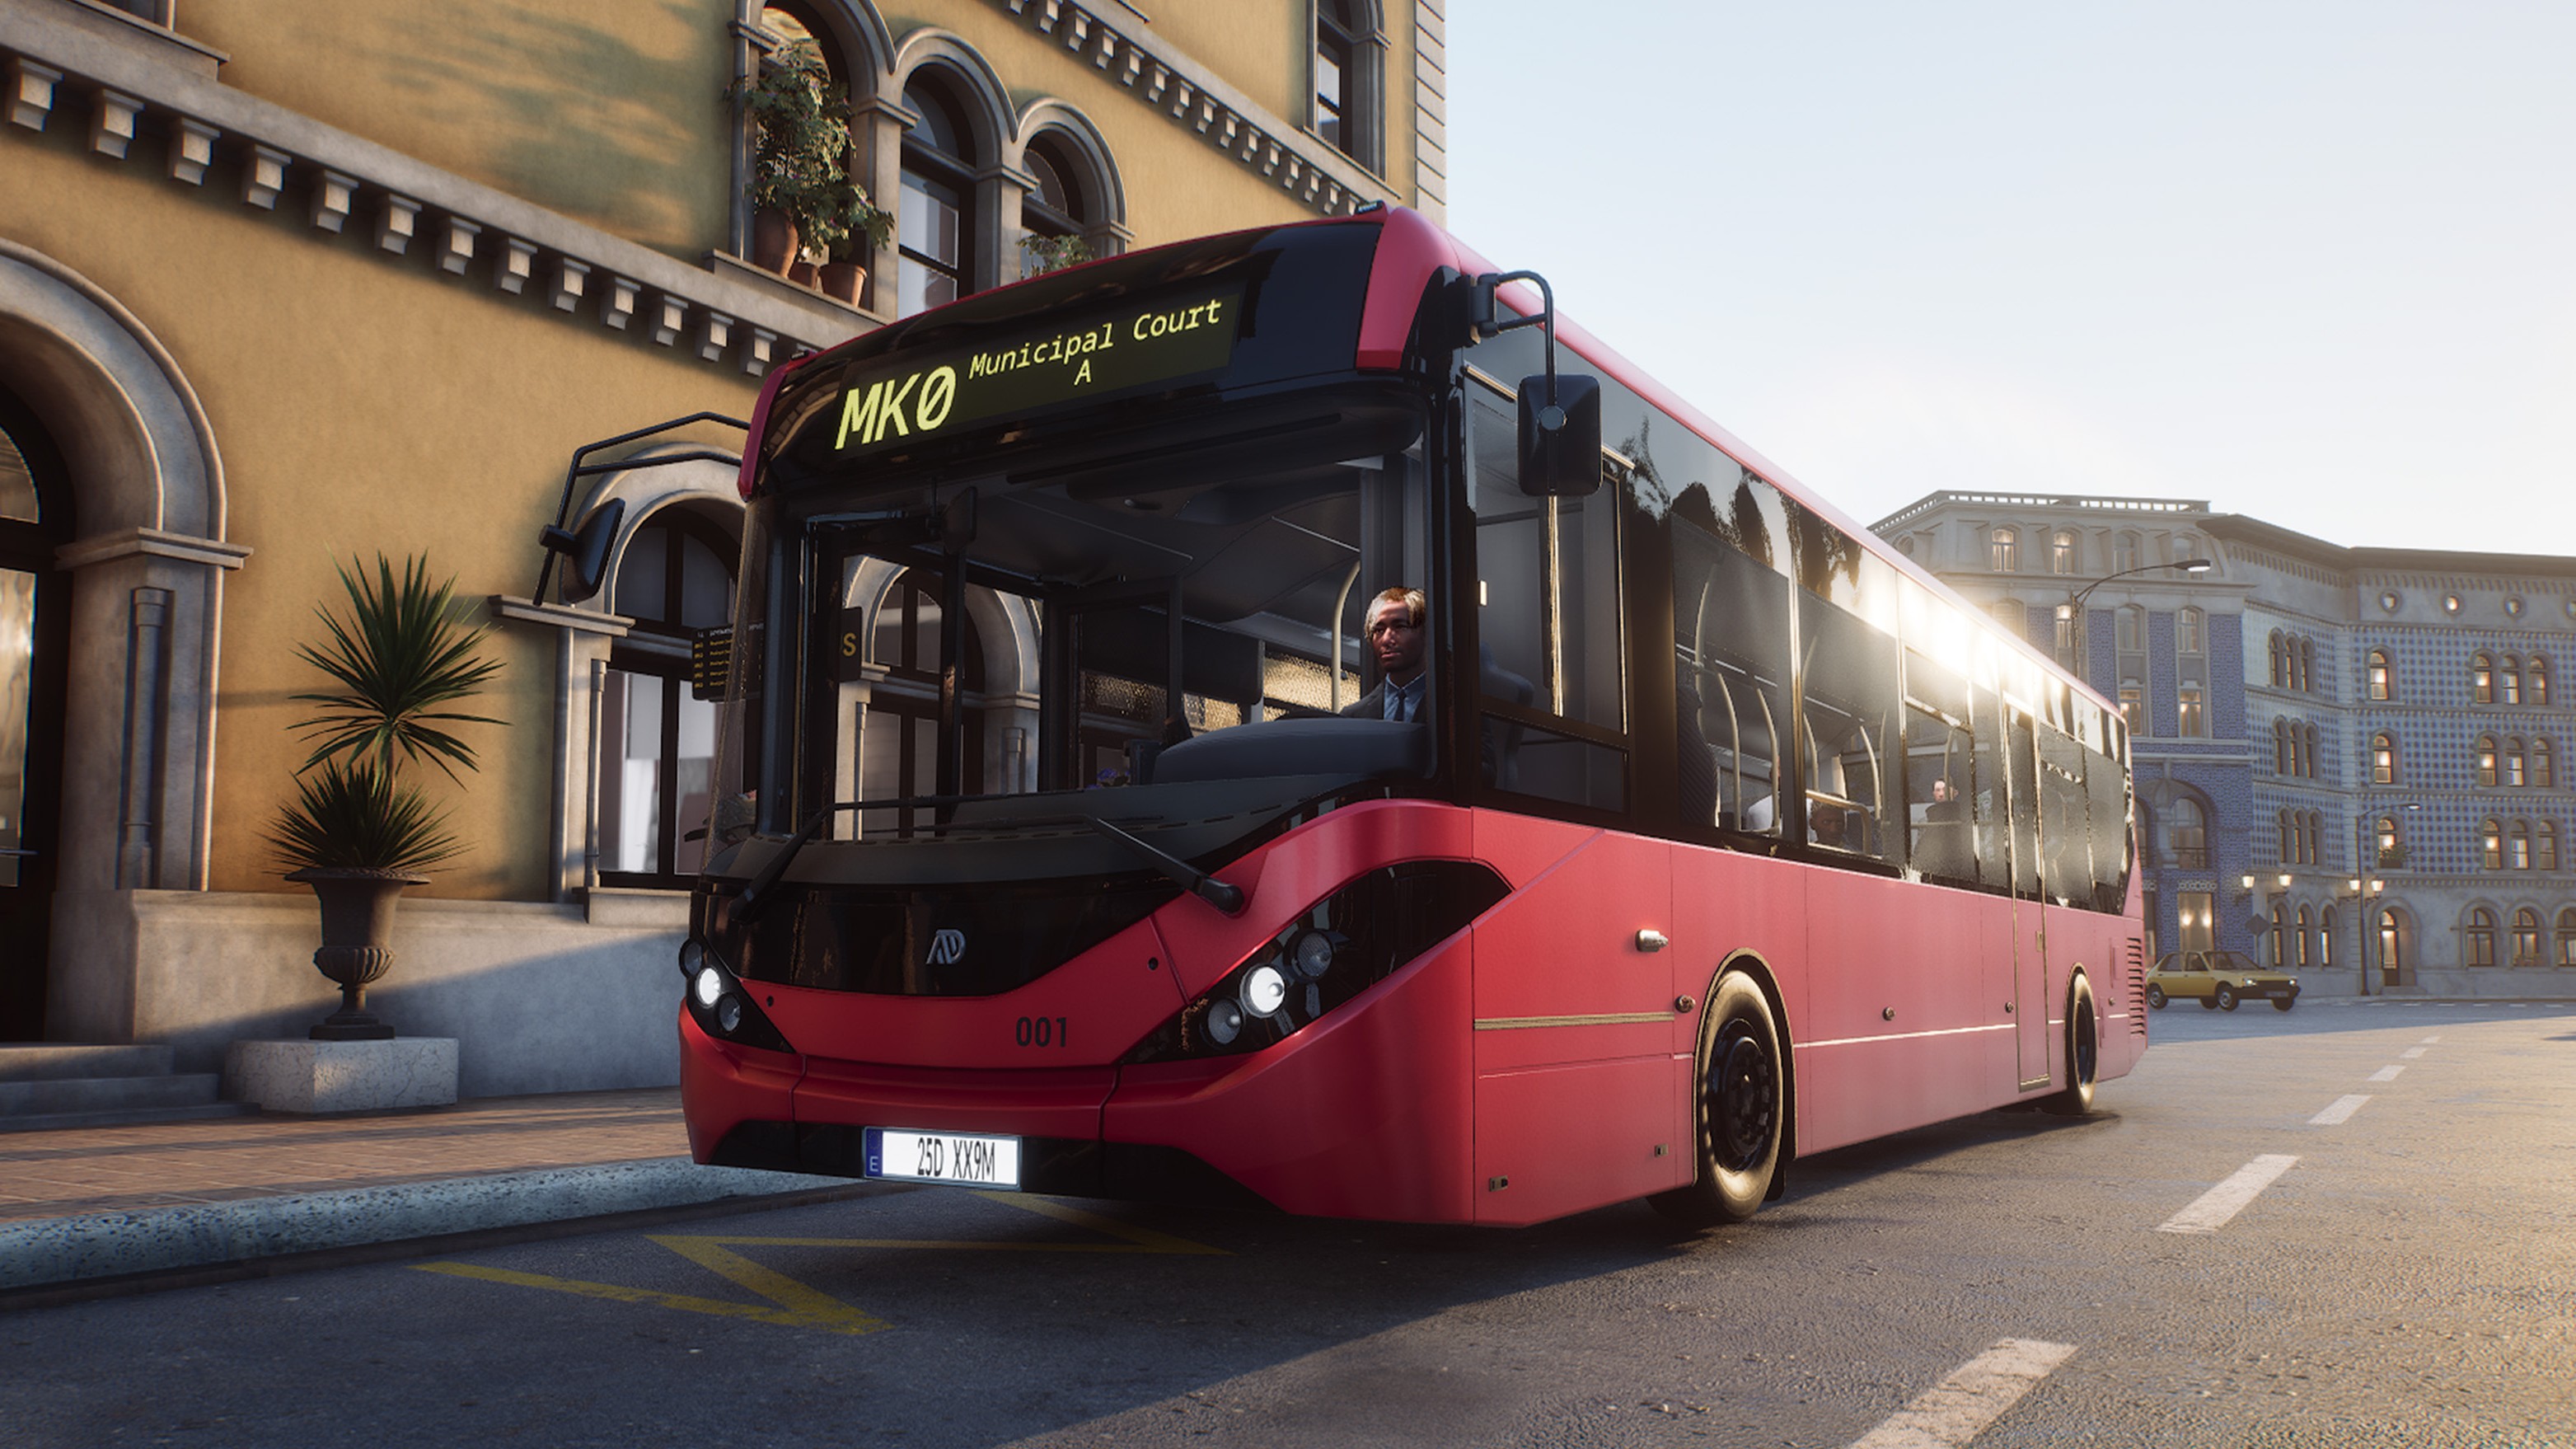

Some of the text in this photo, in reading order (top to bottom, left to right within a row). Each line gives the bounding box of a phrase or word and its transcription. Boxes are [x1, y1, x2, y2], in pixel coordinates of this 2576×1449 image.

[968, 299, 1222, 379] Municipal Court
[1075, 360, 1092, 386] A
[1015, 1016, 1066, 1048] 001
[869, 1137, 995, 1182] E 25D XX9M
